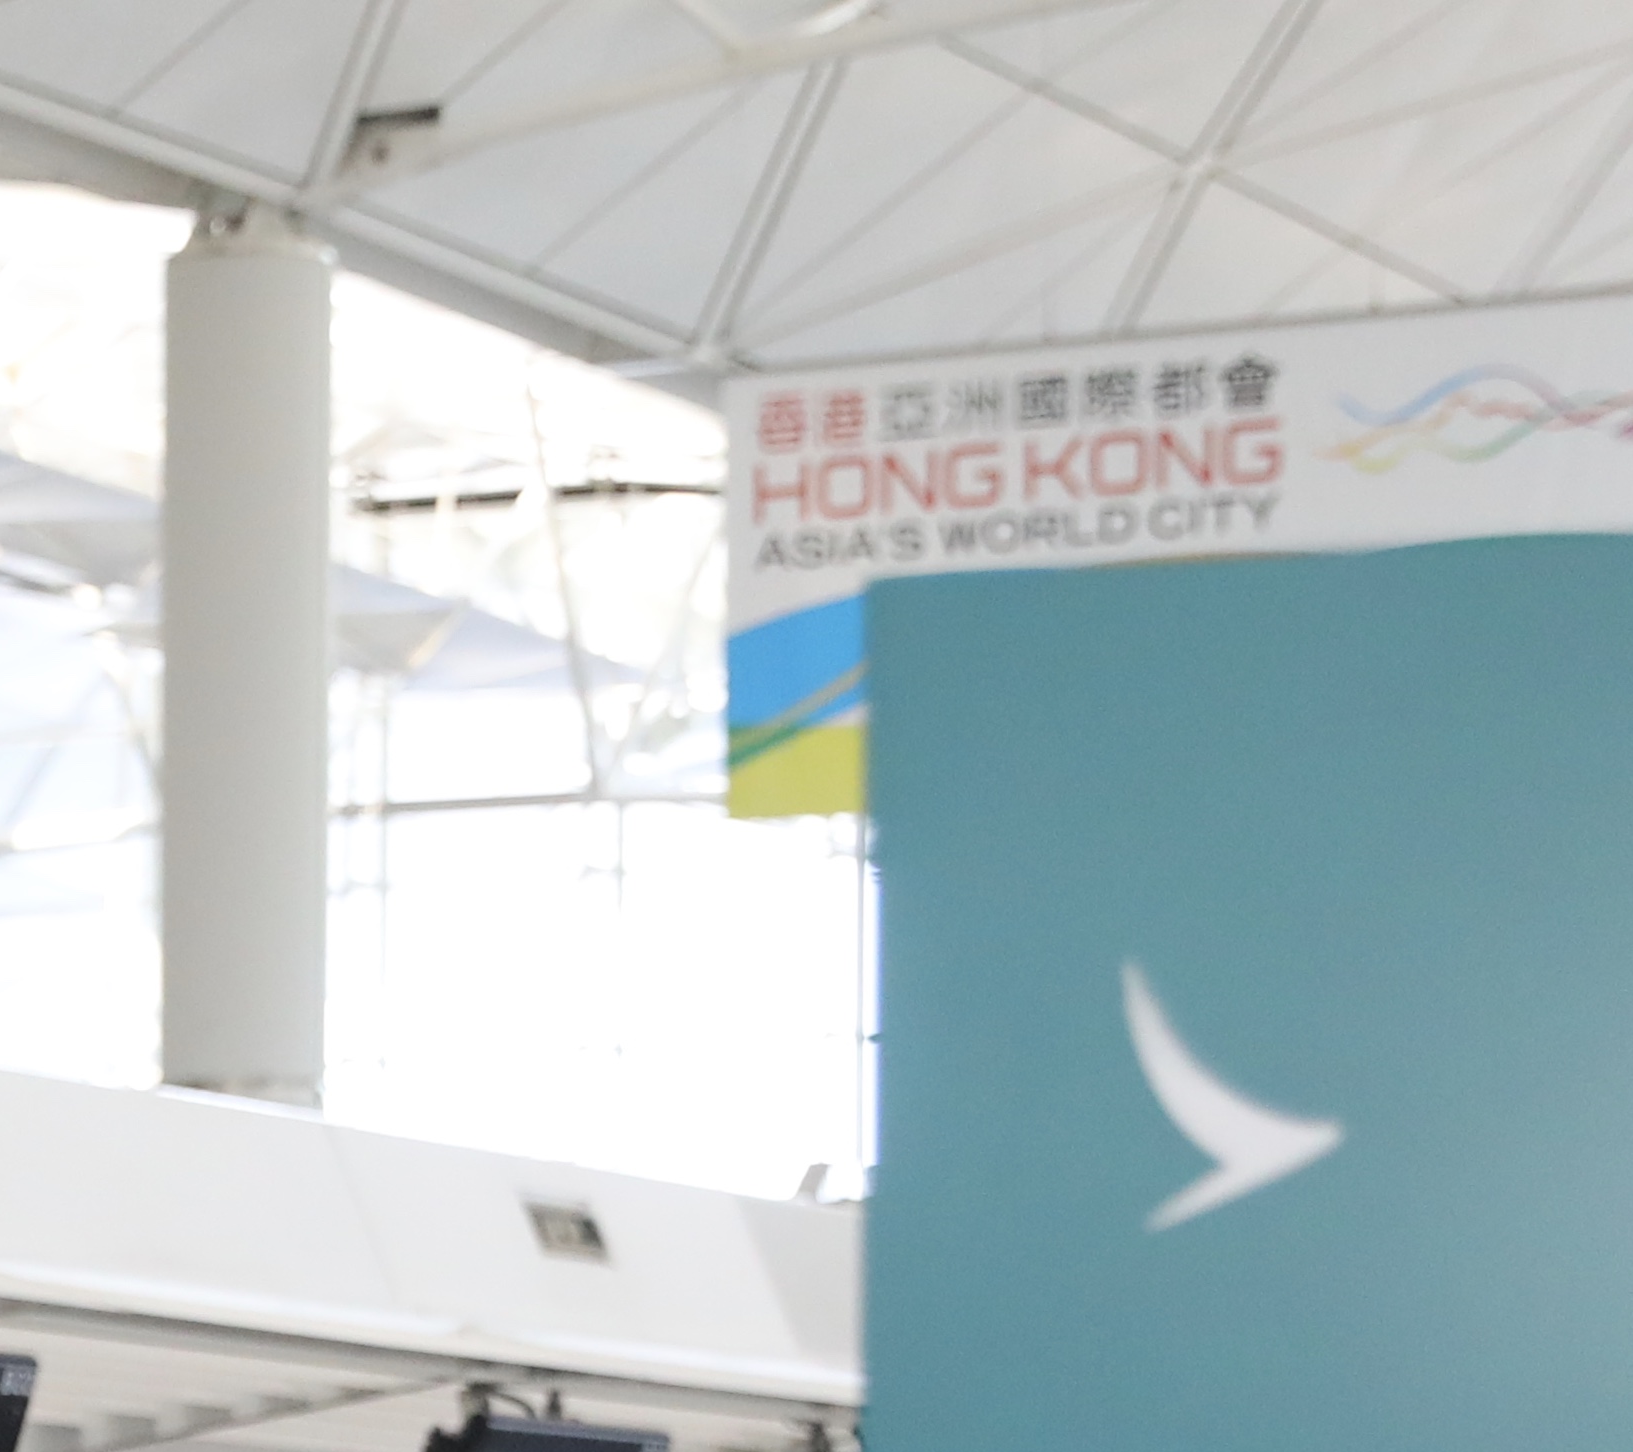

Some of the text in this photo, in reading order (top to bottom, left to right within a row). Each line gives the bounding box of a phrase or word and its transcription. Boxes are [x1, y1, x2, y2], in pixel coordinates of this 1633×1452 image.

[752, 414, 1286, 527] HONG KONG
[756, 491, 1281, 571] ASIA'S WORLD CITY
